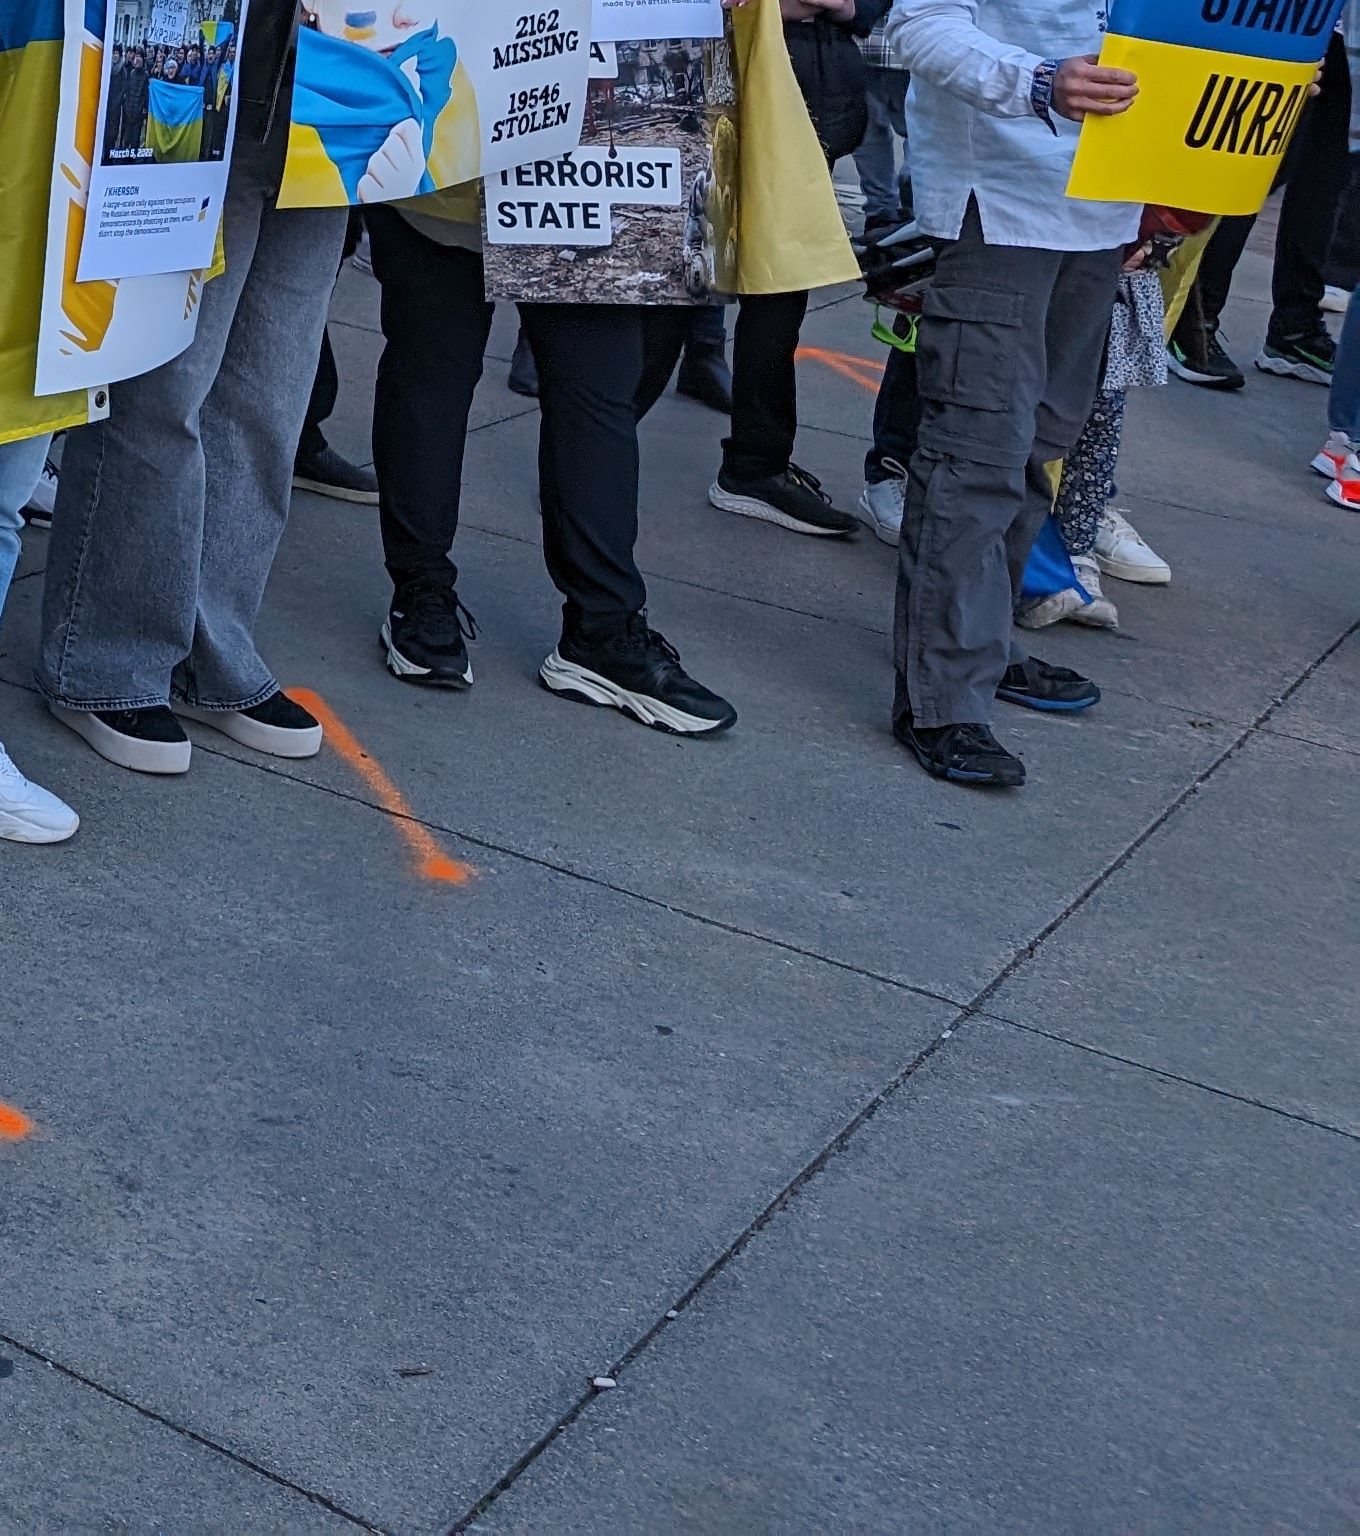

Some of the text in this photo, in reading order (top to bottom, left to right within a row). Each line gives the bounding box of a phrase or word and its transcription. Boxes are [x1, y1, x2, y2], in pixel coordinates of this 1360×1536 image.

[515, 9, 560, 39] 2162
[492, 31, 578, 70] MISSING
[508, 82, 560, 115] 19546
[491, 102, 571, 143] STOLEN
[109, 148, 129, 158] March
[137, 148, 153, 157] 2022
[498, 202, 600, 229] STATE
